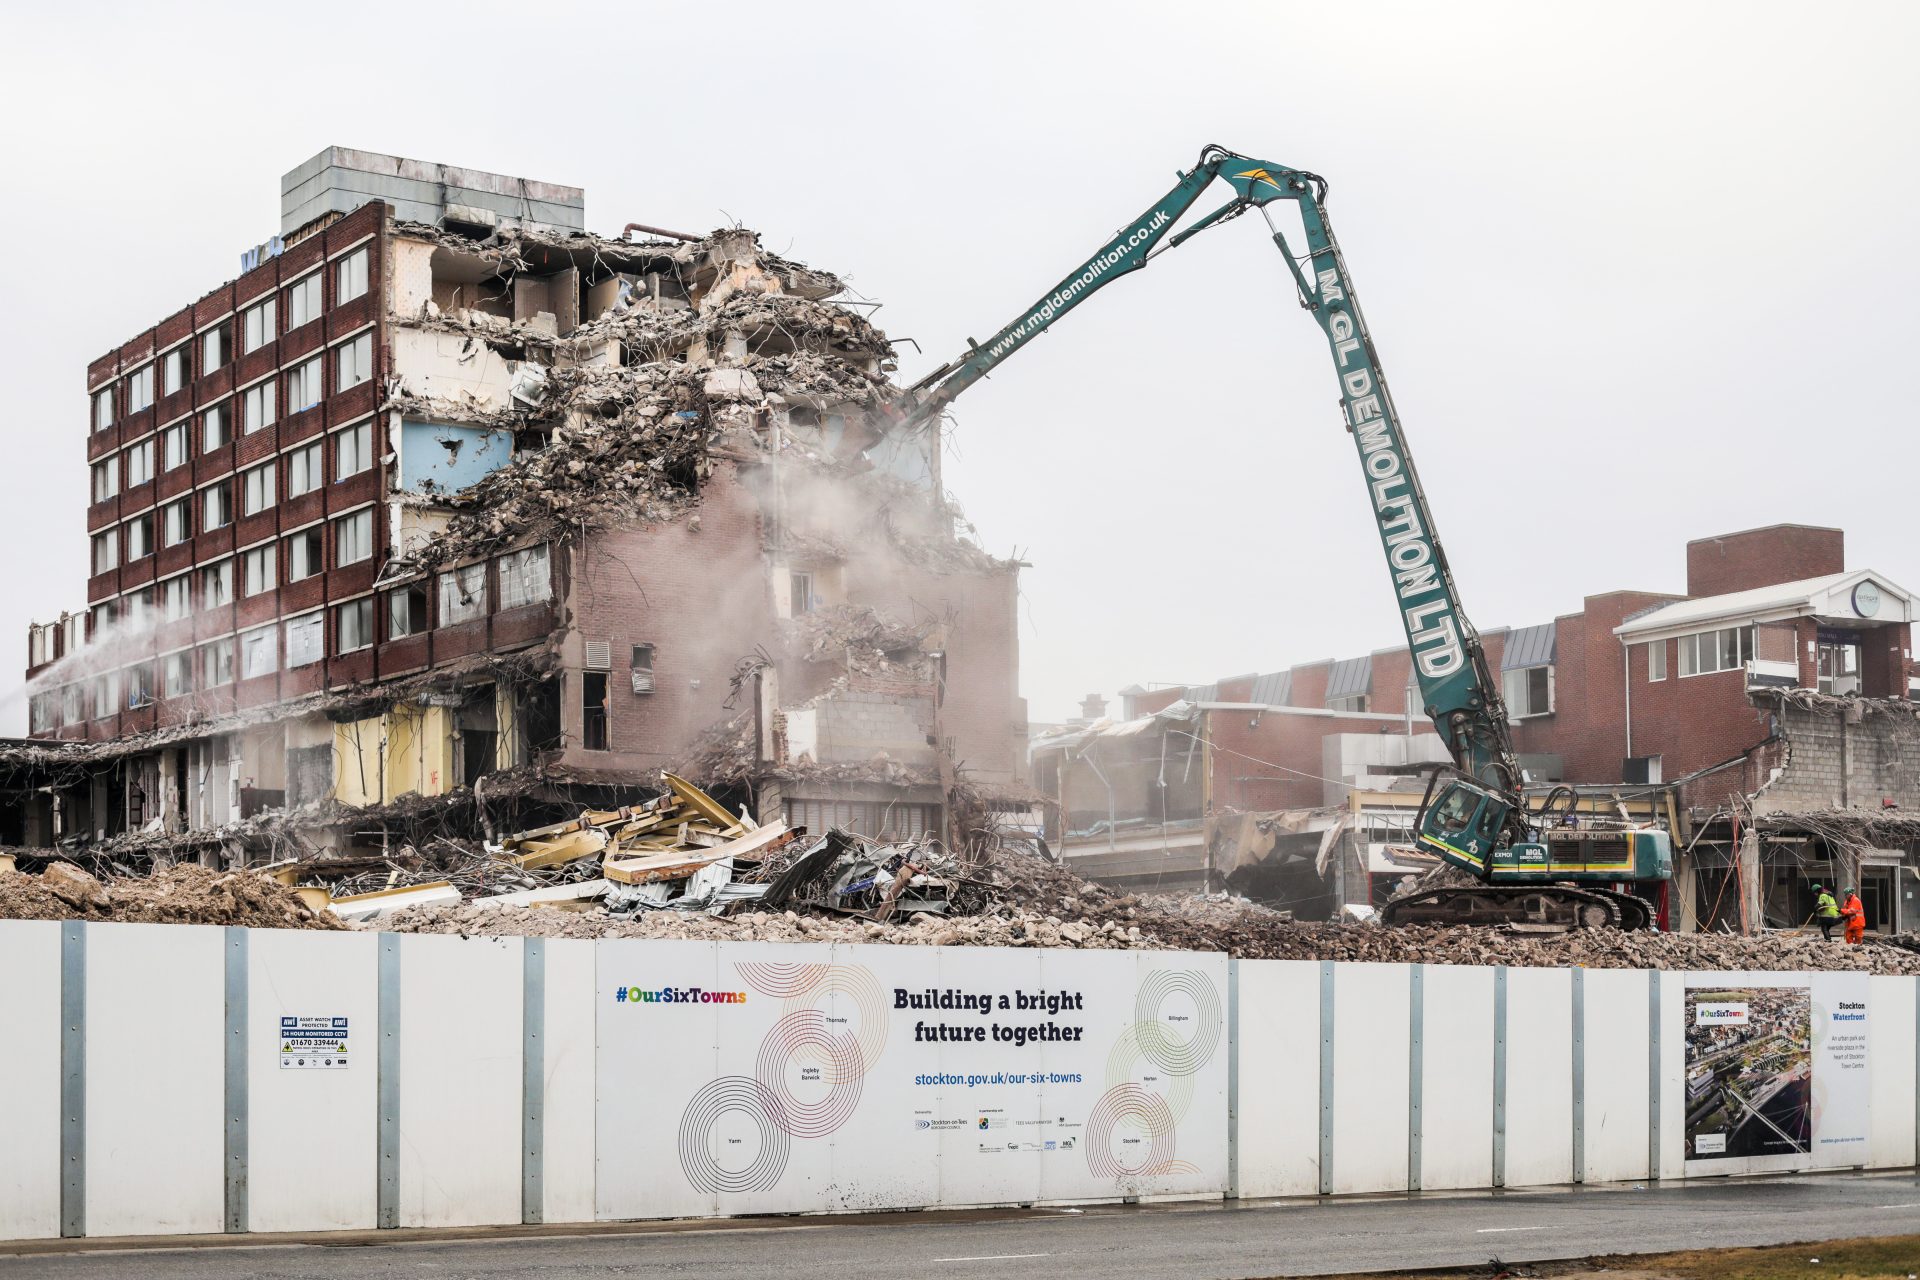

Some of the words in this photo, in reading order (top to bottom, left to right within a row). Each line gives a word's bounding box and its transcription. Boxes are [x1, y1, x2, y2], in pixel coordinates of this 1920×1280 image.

[989, 209, 1171, 358] www.mgldemolition.co.uk
[1317, 267, 1361, 367] MGL
[1343, 367, 1441, 599] DEMOLITION
[1405, 598, 1465, 678] LTD
[1525, 848, 1543, 856] MGL
[616, 986, 747, 1004] #OurSixTowns
[894, 988, 993, 1015] Building
[998, 994, 1011, 1010] a
[1015, 990, 1084, 1016] bright
[1701, 1010, 1745, 1018] #OurSixTowns
[1839, 1002, 1866, 1010] Stockton
[1832, 1013, 1866, 1021] Waterfront
[915, 1021, 986, 1042] future
[992, 1021, 1083, 1047] together
[915, 1072, 1082, 1087] stockton.gov.uk/our-six-towns
